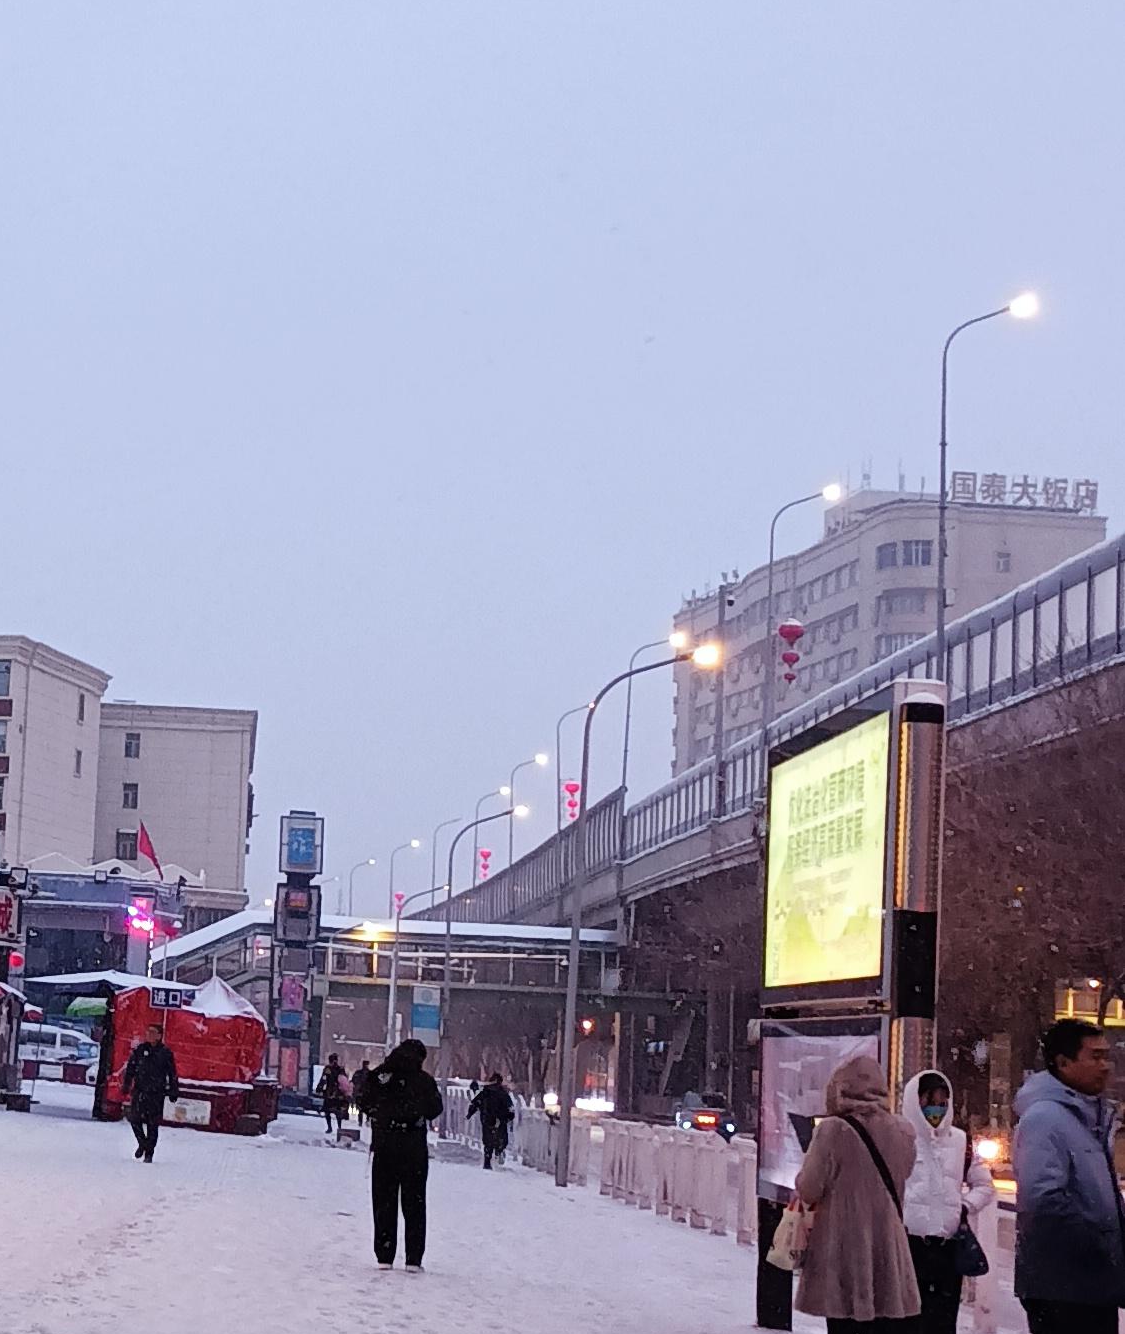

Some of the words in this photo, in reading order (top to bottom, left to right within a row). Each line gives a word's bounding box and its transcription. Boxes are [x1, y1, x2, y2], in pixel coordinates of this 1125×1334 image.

[951, 470, 1099, 511] 国泰大饭店
[153, 989, 181, 1006] 进口
